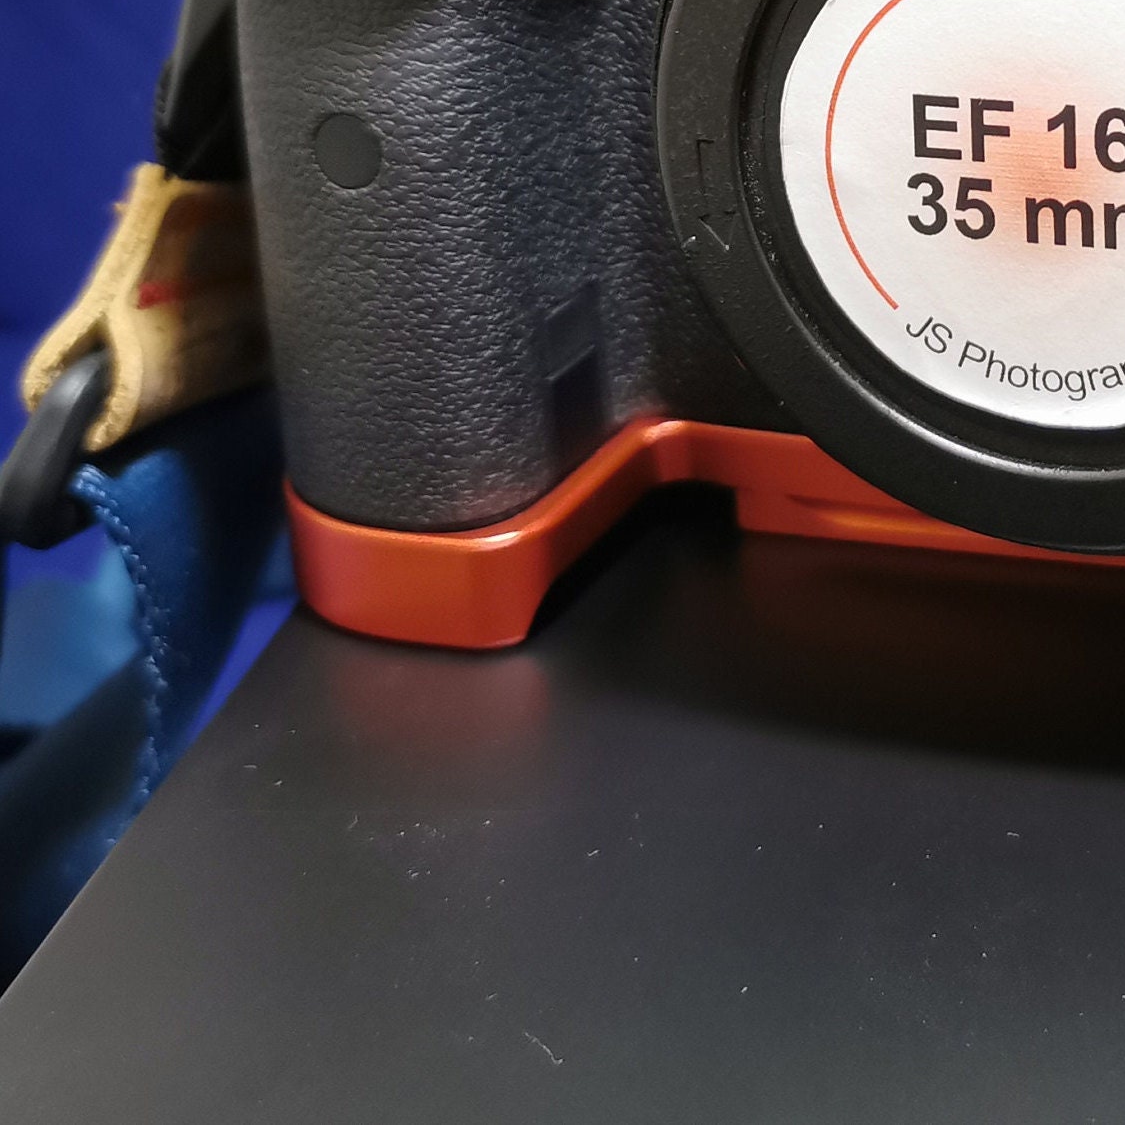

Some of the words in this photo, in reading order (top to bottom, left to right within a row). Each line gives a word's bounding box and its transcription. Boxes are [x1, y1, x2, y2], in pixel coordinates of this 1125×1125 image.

[912, 94, 1014, 163] EF
[907, 172, 996, 240] 35
[905, 316, 953, 354] JS
